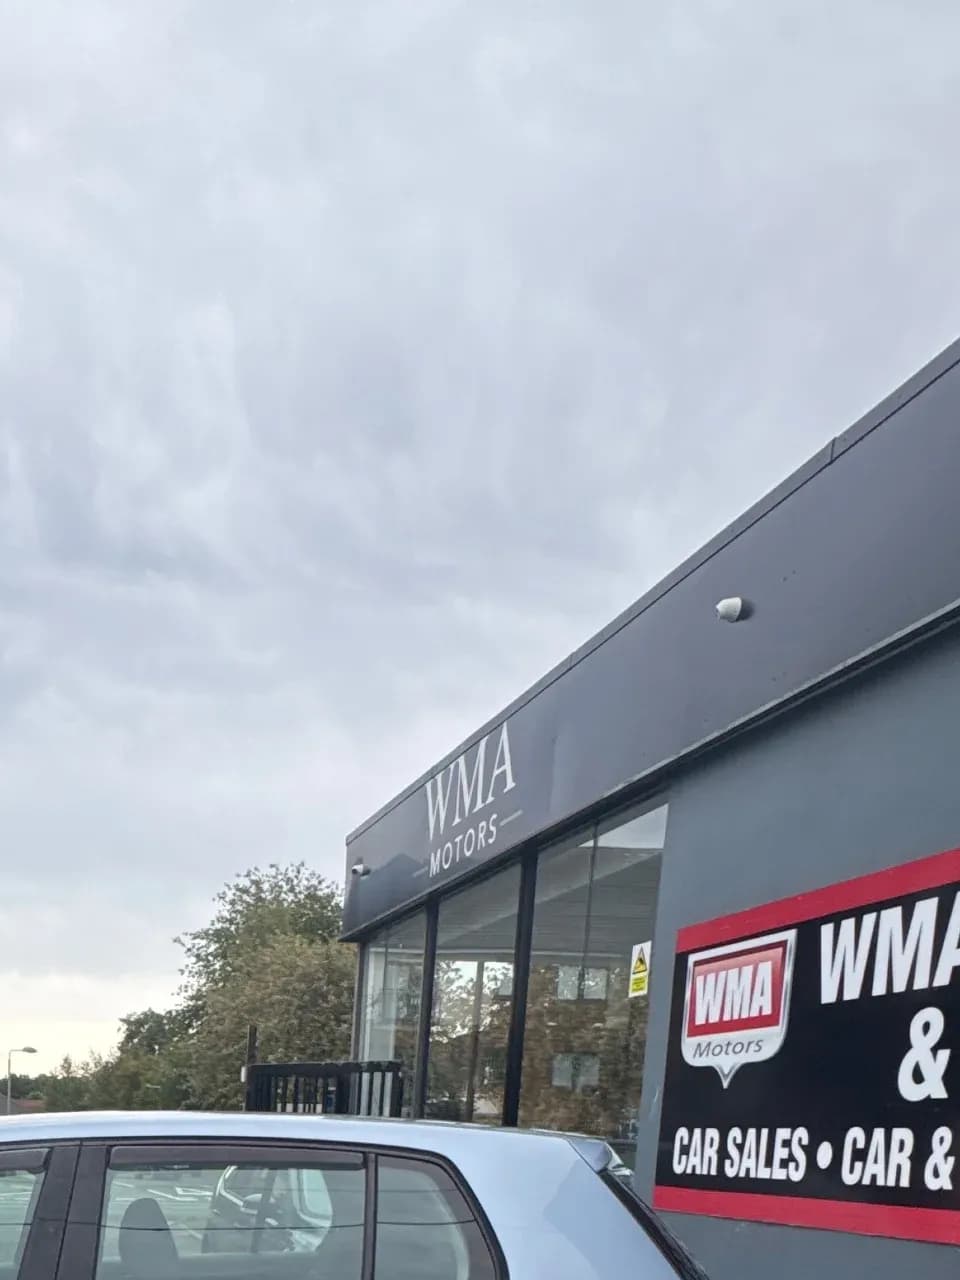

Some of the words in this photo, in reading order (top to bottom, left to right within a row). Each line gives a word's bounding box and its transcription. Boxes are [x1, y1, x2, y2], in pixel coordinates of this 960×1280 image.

[425, 721, 516, 842] WMA
[429, 813, 498, 878] MOTORS
[694, 960, 773, 1026] WMA
[693, 1036, 764, 1060] Motors
[897, 1006, 951, 1102] &
[672, 1126, 721, 1177] CAR
[724, 1126, 809, 1183] SALES
[841, 1126, 916, 1188] CAR
[924, 1126, 956, 1191] &
